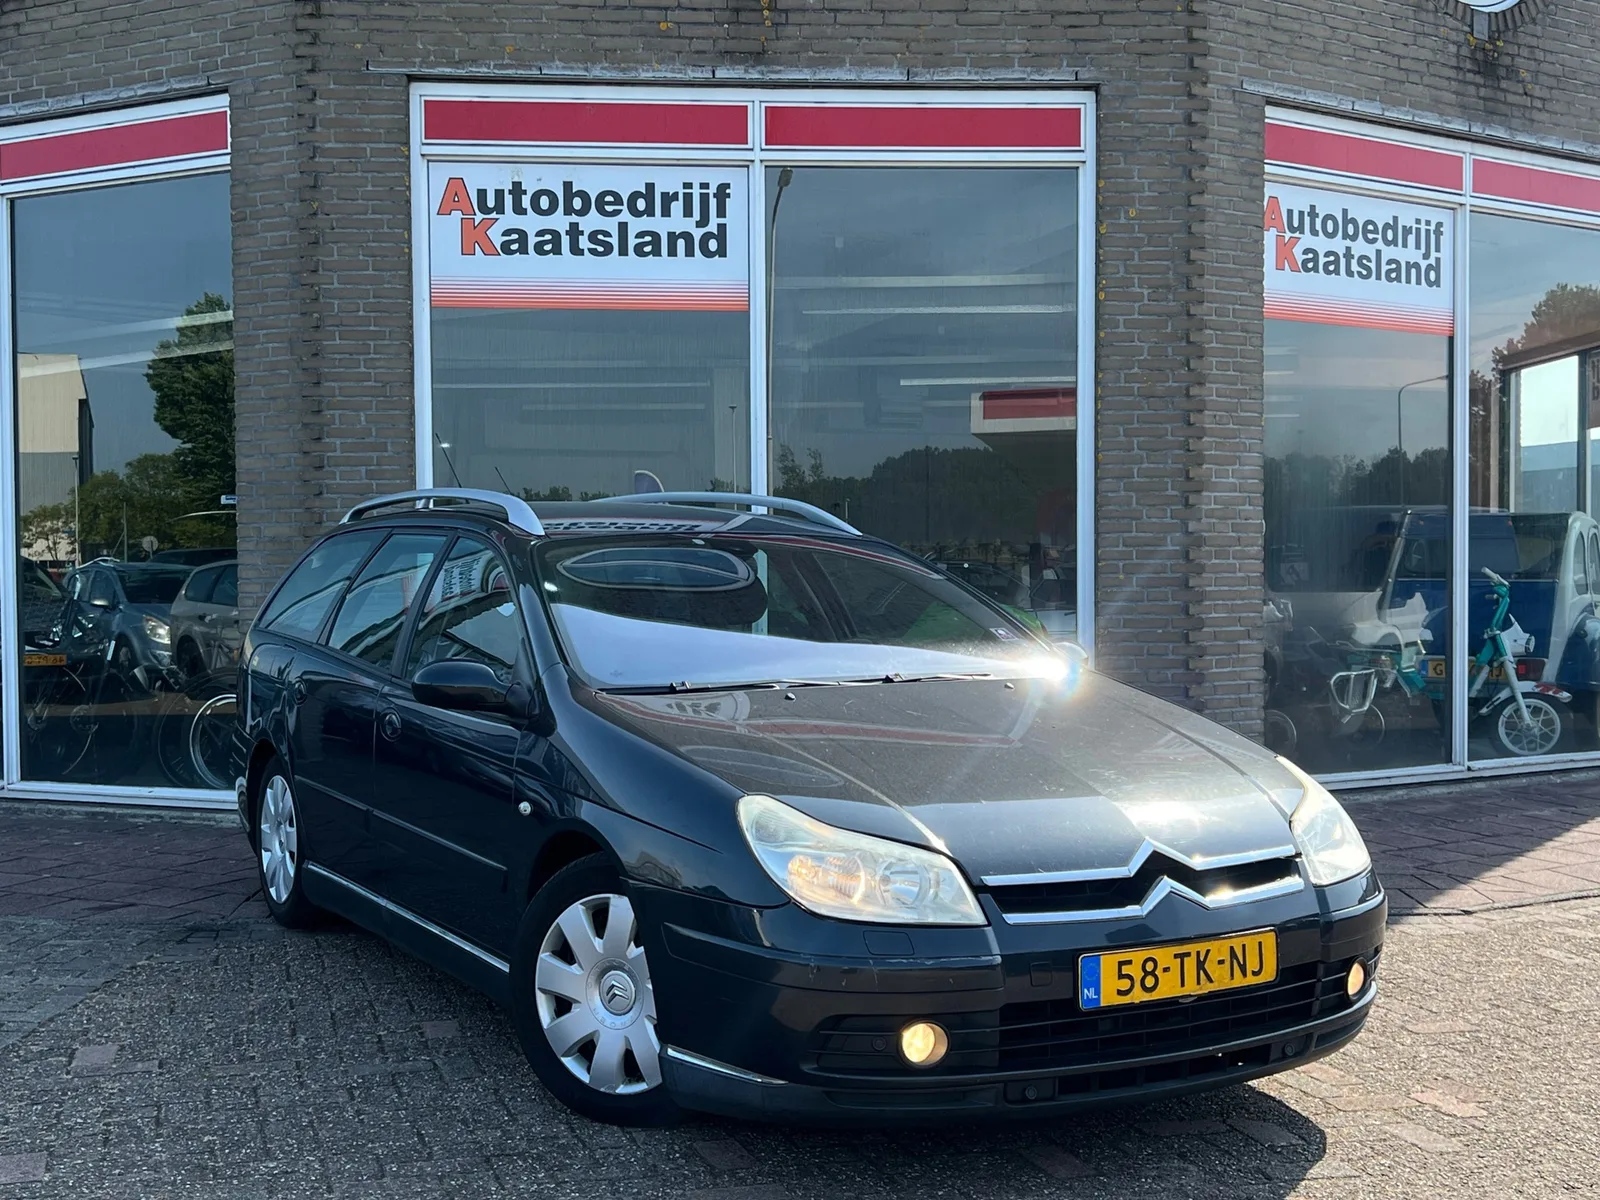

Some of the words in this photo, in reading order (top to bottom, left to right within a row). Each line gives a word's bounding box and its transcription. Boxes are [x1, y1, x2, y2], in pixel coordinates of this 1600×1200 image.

[437, 177, 731, 228] Autobedrijf
[1264, 196, 1444, 260] Autobedrijf
[460, 217, 728, 258] Kaatsland
[1275, 234, 1442, 288] Kaatsland
[1083, 987, 1099, 1000] NL
[1116, 941, 1264, 997] 58-TK-NJ
